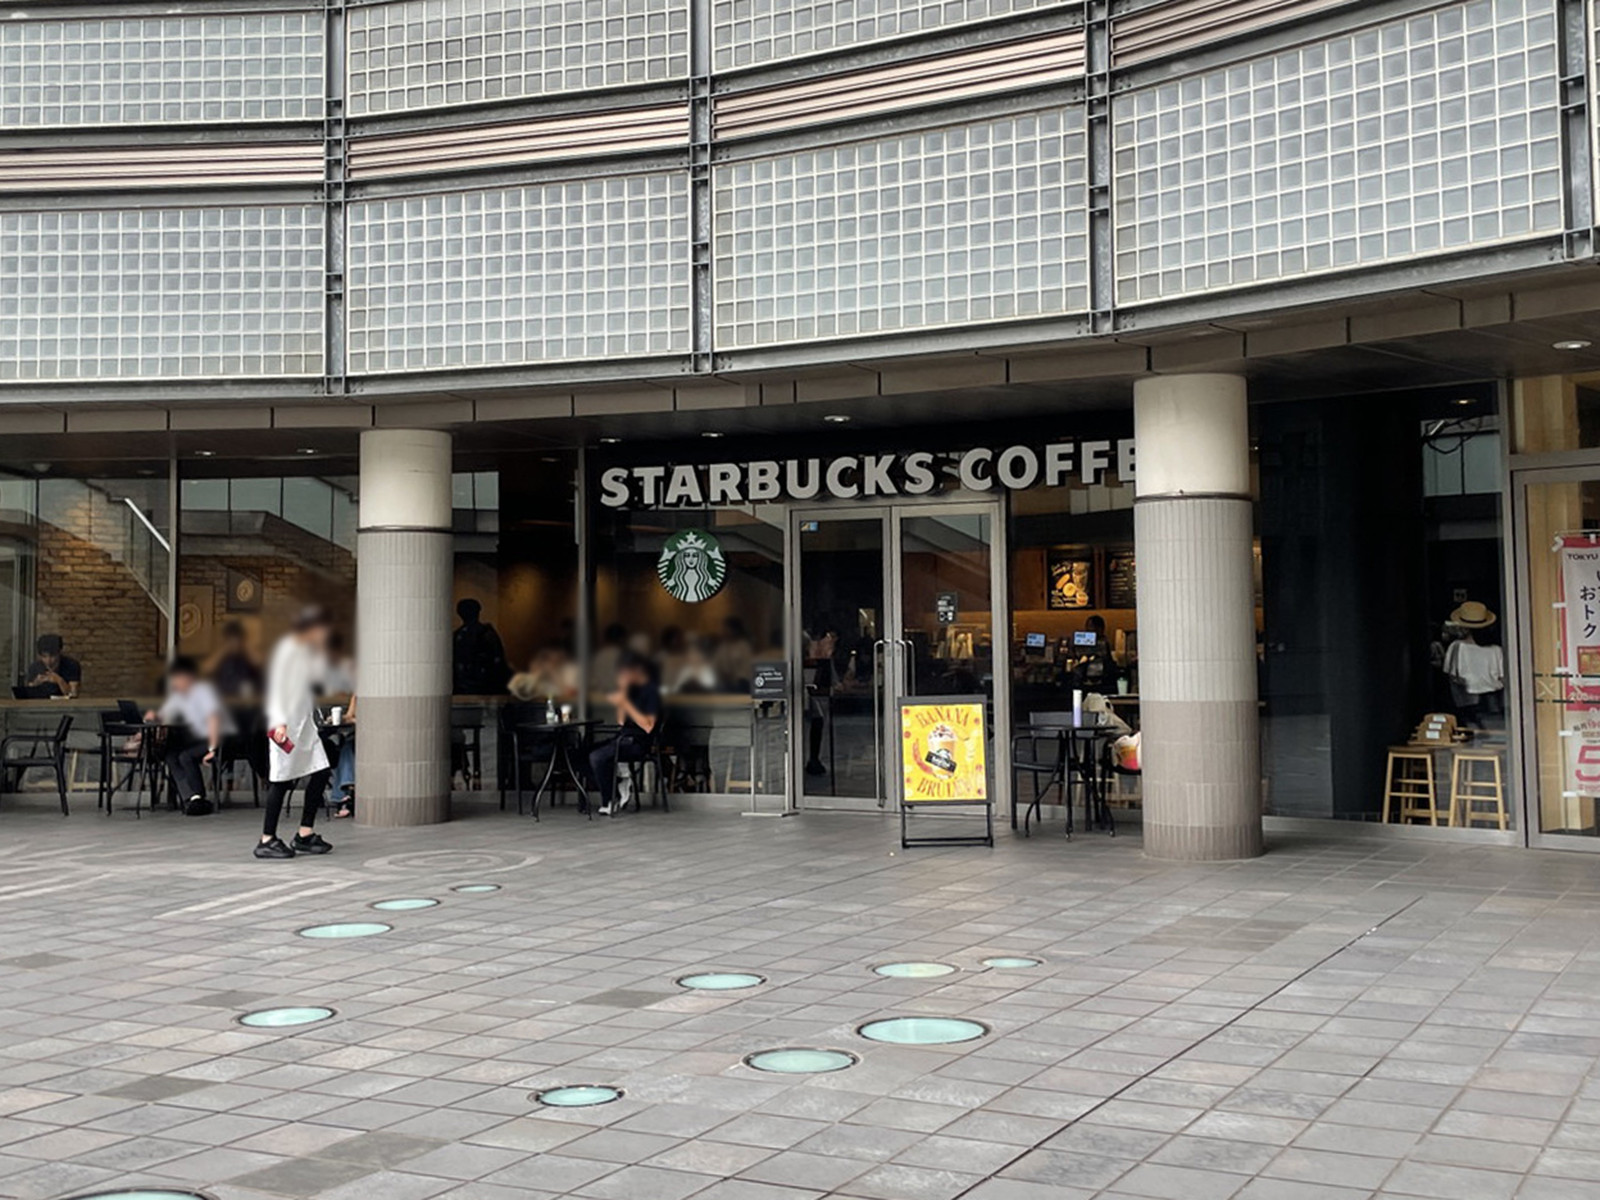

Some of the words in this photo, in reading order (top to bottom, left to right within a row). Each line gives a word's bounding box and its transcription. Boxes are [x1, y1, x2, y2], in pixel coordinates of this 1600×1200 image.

[600, 452, 935, 508] STARBUCKS
[1567, 553, 1599, 561] TOKYU
[1580, 585, 1598, 639] おトク
